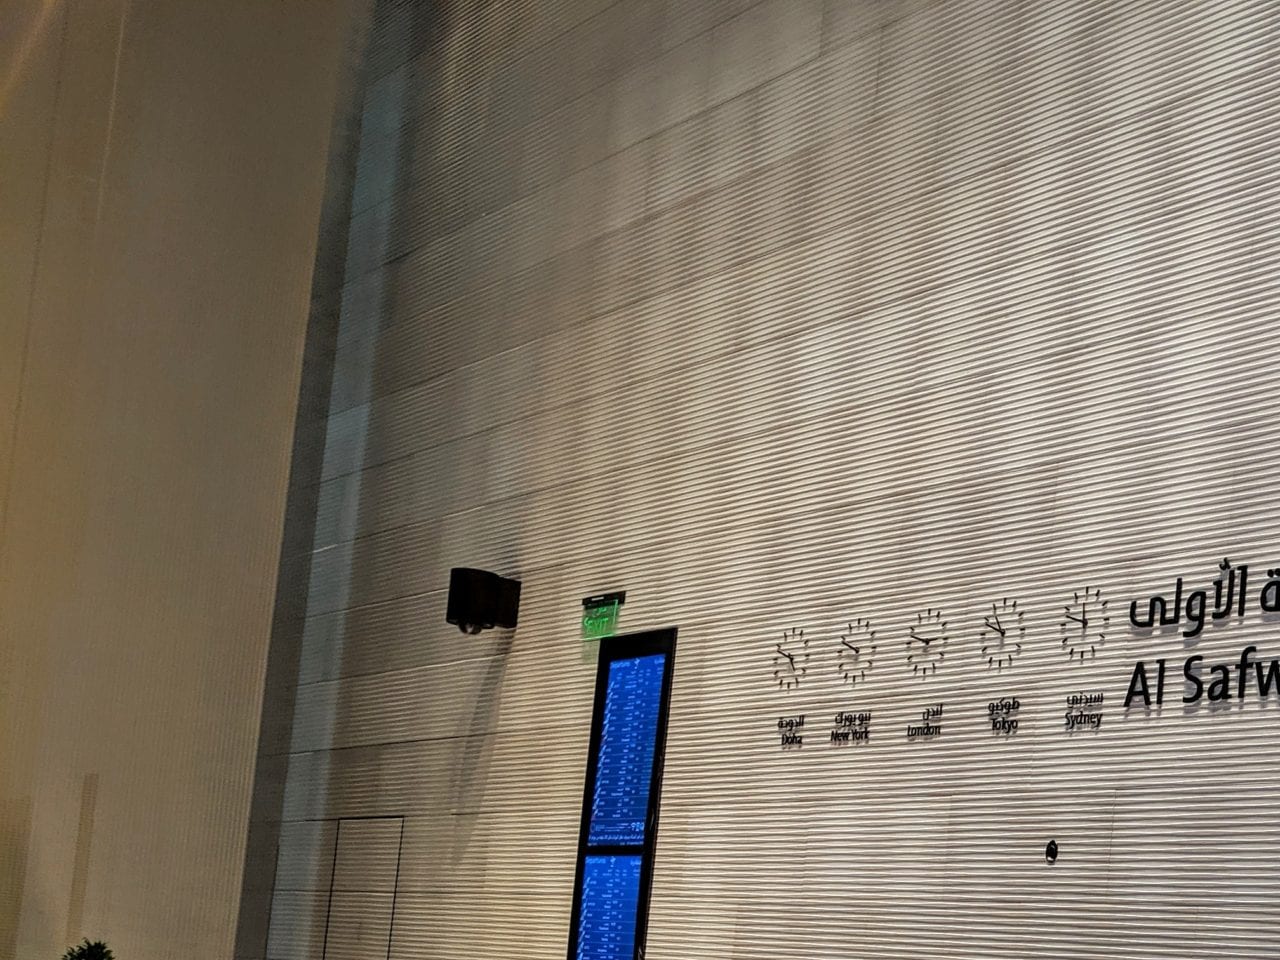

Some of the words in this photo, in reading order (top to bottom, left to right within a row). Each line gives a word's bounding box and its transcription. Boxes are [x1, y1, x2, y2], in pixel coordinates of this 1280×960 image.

[1123, 659, 1167, 707] Al
[991, 717, 1019, 734] Tokyo
[1064, 710, 1103, 729] Sydney
[831, 730, 850, 742] New
[851, 727, 871, 741] York
[906, 723, 941, 737] London
[781, 732, 803, 746] Doha
